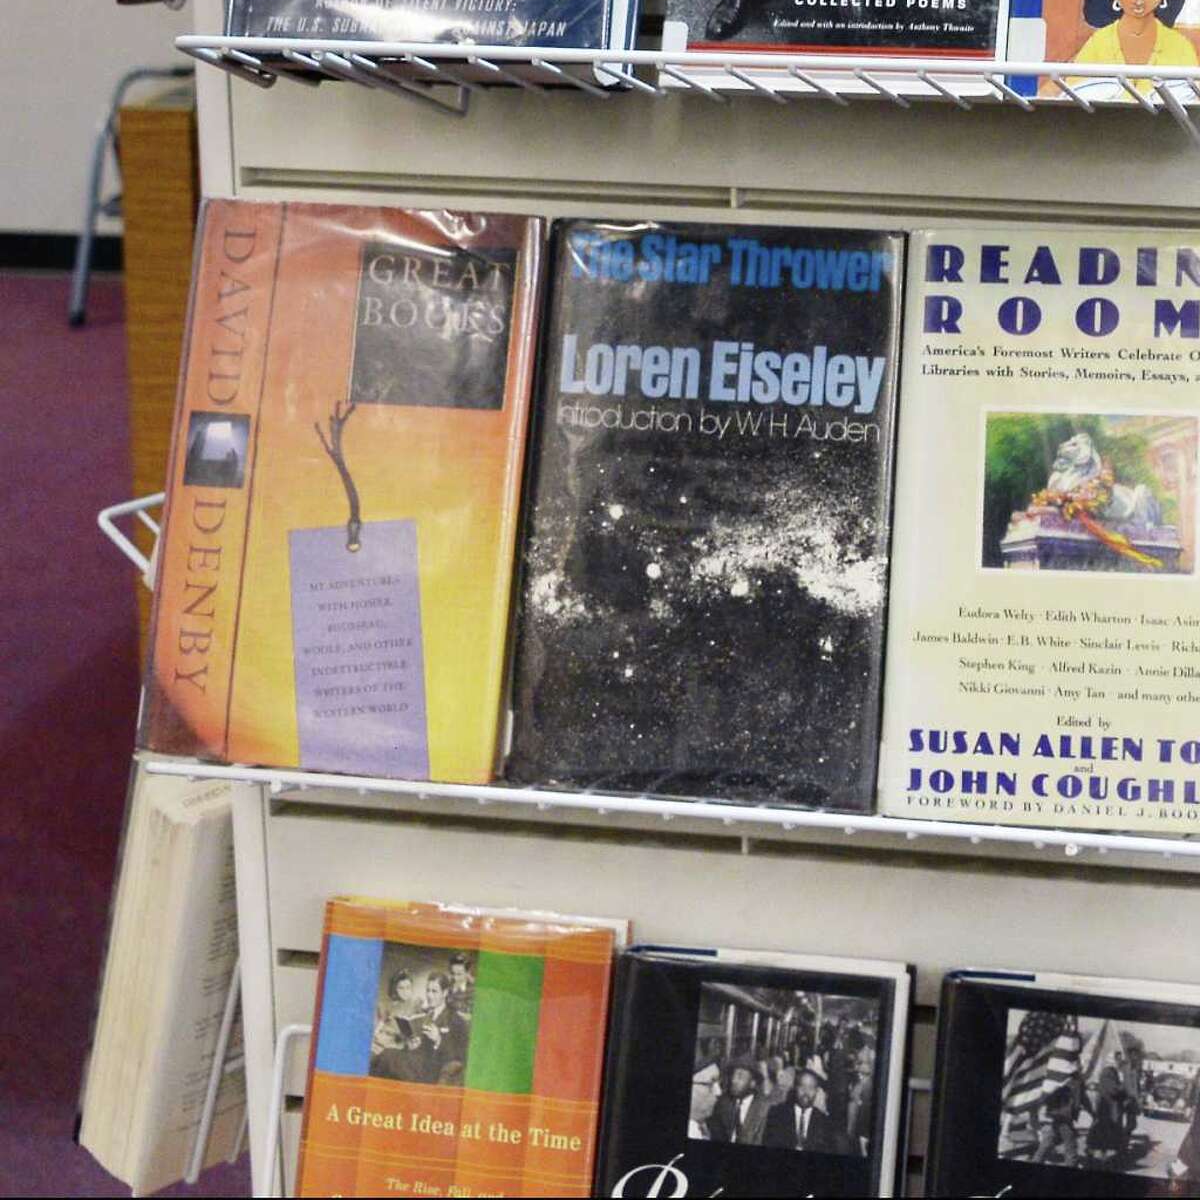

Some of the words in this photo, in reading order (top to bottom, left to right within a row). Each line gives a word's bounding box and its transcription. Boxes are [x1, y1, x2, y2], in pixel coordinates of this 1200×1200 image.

[266, 16, 290, 32] THE
[297, 17, 324, 32] U.S.
[522, 20, 567, 37] JAPAN
[369, 255, 511, 290] GREAT
[570, 231, 634, 281] The
[640, 234, 722, 284] Star
[728, 235, 889, 292] Thrower
[207, 228, 257, 403] DAVID
[922, 344, 985, 357] America's
[993, 345, 1054, 359] Foremost
[1060, 347, 1111, 361] Writers
[1117, 349, 1182, 362] Celebrate
[559, 334, 700, 399] Loren
[709, 340, 886, 414] Eiseley
[922, 364, 980, 377] Libraries
[986, 365, 1014, 378] with
[1019, 366, 1070, 382] Stories,
[1074, 367, 1136, 383] Memoirs,
[1141, 369, 1190, 385] Essays,
[557, 402, 692, 432] Introduction
[700, 406, 731, 439] by
[793, 414, 880, 443] Auden
[173, 498, 227, 694] DENBY
[958, 606, 1000, 620] Eudora
[1045, 610, 1077, 623] Edith
[1080, 611, 1132, 625] Wharton
[912, 631, 949, 644] James
[952, 632, 999, 646] Baldwin
[1036, 635, 1072, 648] White
[1079, 637, 1123, 650] Sinclair
[959, 657, 1005, 673] Stephen
[1008, 659, 1036, 674] King
[1050, 661, 1086, 674] Alfred
[1088, 663, 1122, 676] Kazin
[959, 681, 991, 695] Nikki
[994, 682, 1046, 697] Giovanni
[1054, 686, 1081, 700] Amy
[1085, 687, 1105, 699] Tan
[1118, 689, 1139, 701] and
[1142, 692, 1173, 705] many
[1057, 715, 1092, 728] Edited
[1098, 716, 1111, 730] by
[909, 728, 1021, 756] SUSAN
[1033, 733, 1143, 762] ALLEN
[1074, 762, 1094, 773] and
[906, 768, 1017, 796] JOHN
[906, 795, 1014, 812] FOREWORD
[1023, 800, 1043, 813] BY
[1053, 801, 1128, 817] DANIEL
[326, 1104, 341, 1122] A
[346, 1105, 404, 1131] Great
[410, 1112, 454, 1137] Idea
[460, 1121, 482, 1140] at
[488, 1122, 522, 1145] the
[528, 1126, 582, 1152] Time
